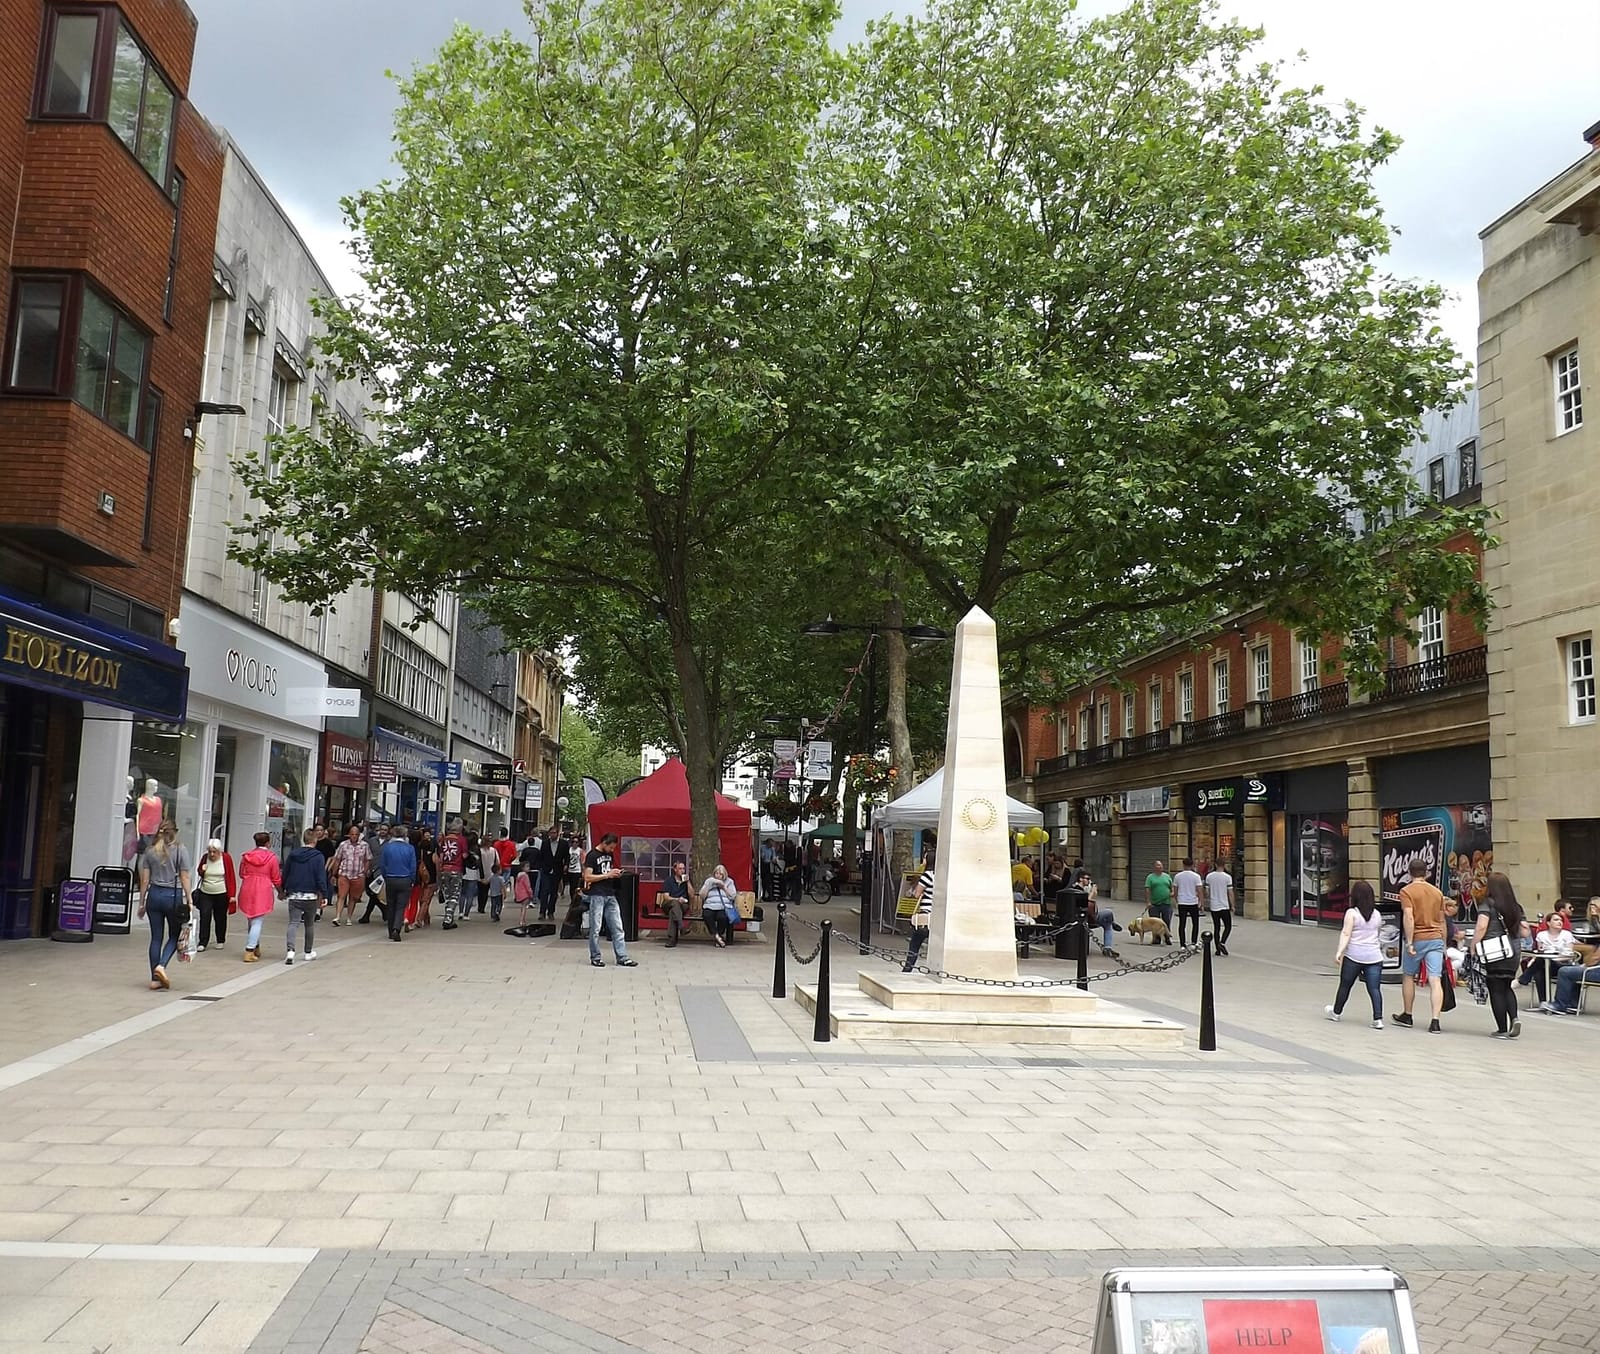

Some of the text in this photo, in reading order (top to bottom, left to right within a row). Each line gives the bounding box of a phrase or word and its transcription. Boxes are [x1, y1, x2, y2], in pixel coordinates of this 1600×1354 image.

[2, 626, 121, 690] HORIZON
[239, 653, 278, 697] YOURS
[332, 698, 355, 707] YOURS
[331, 744, 364, 767] TIMPSON
[1207, 785, 1234, 800] sweatshop
[1237, 1327, 1292, 1347] HELP
